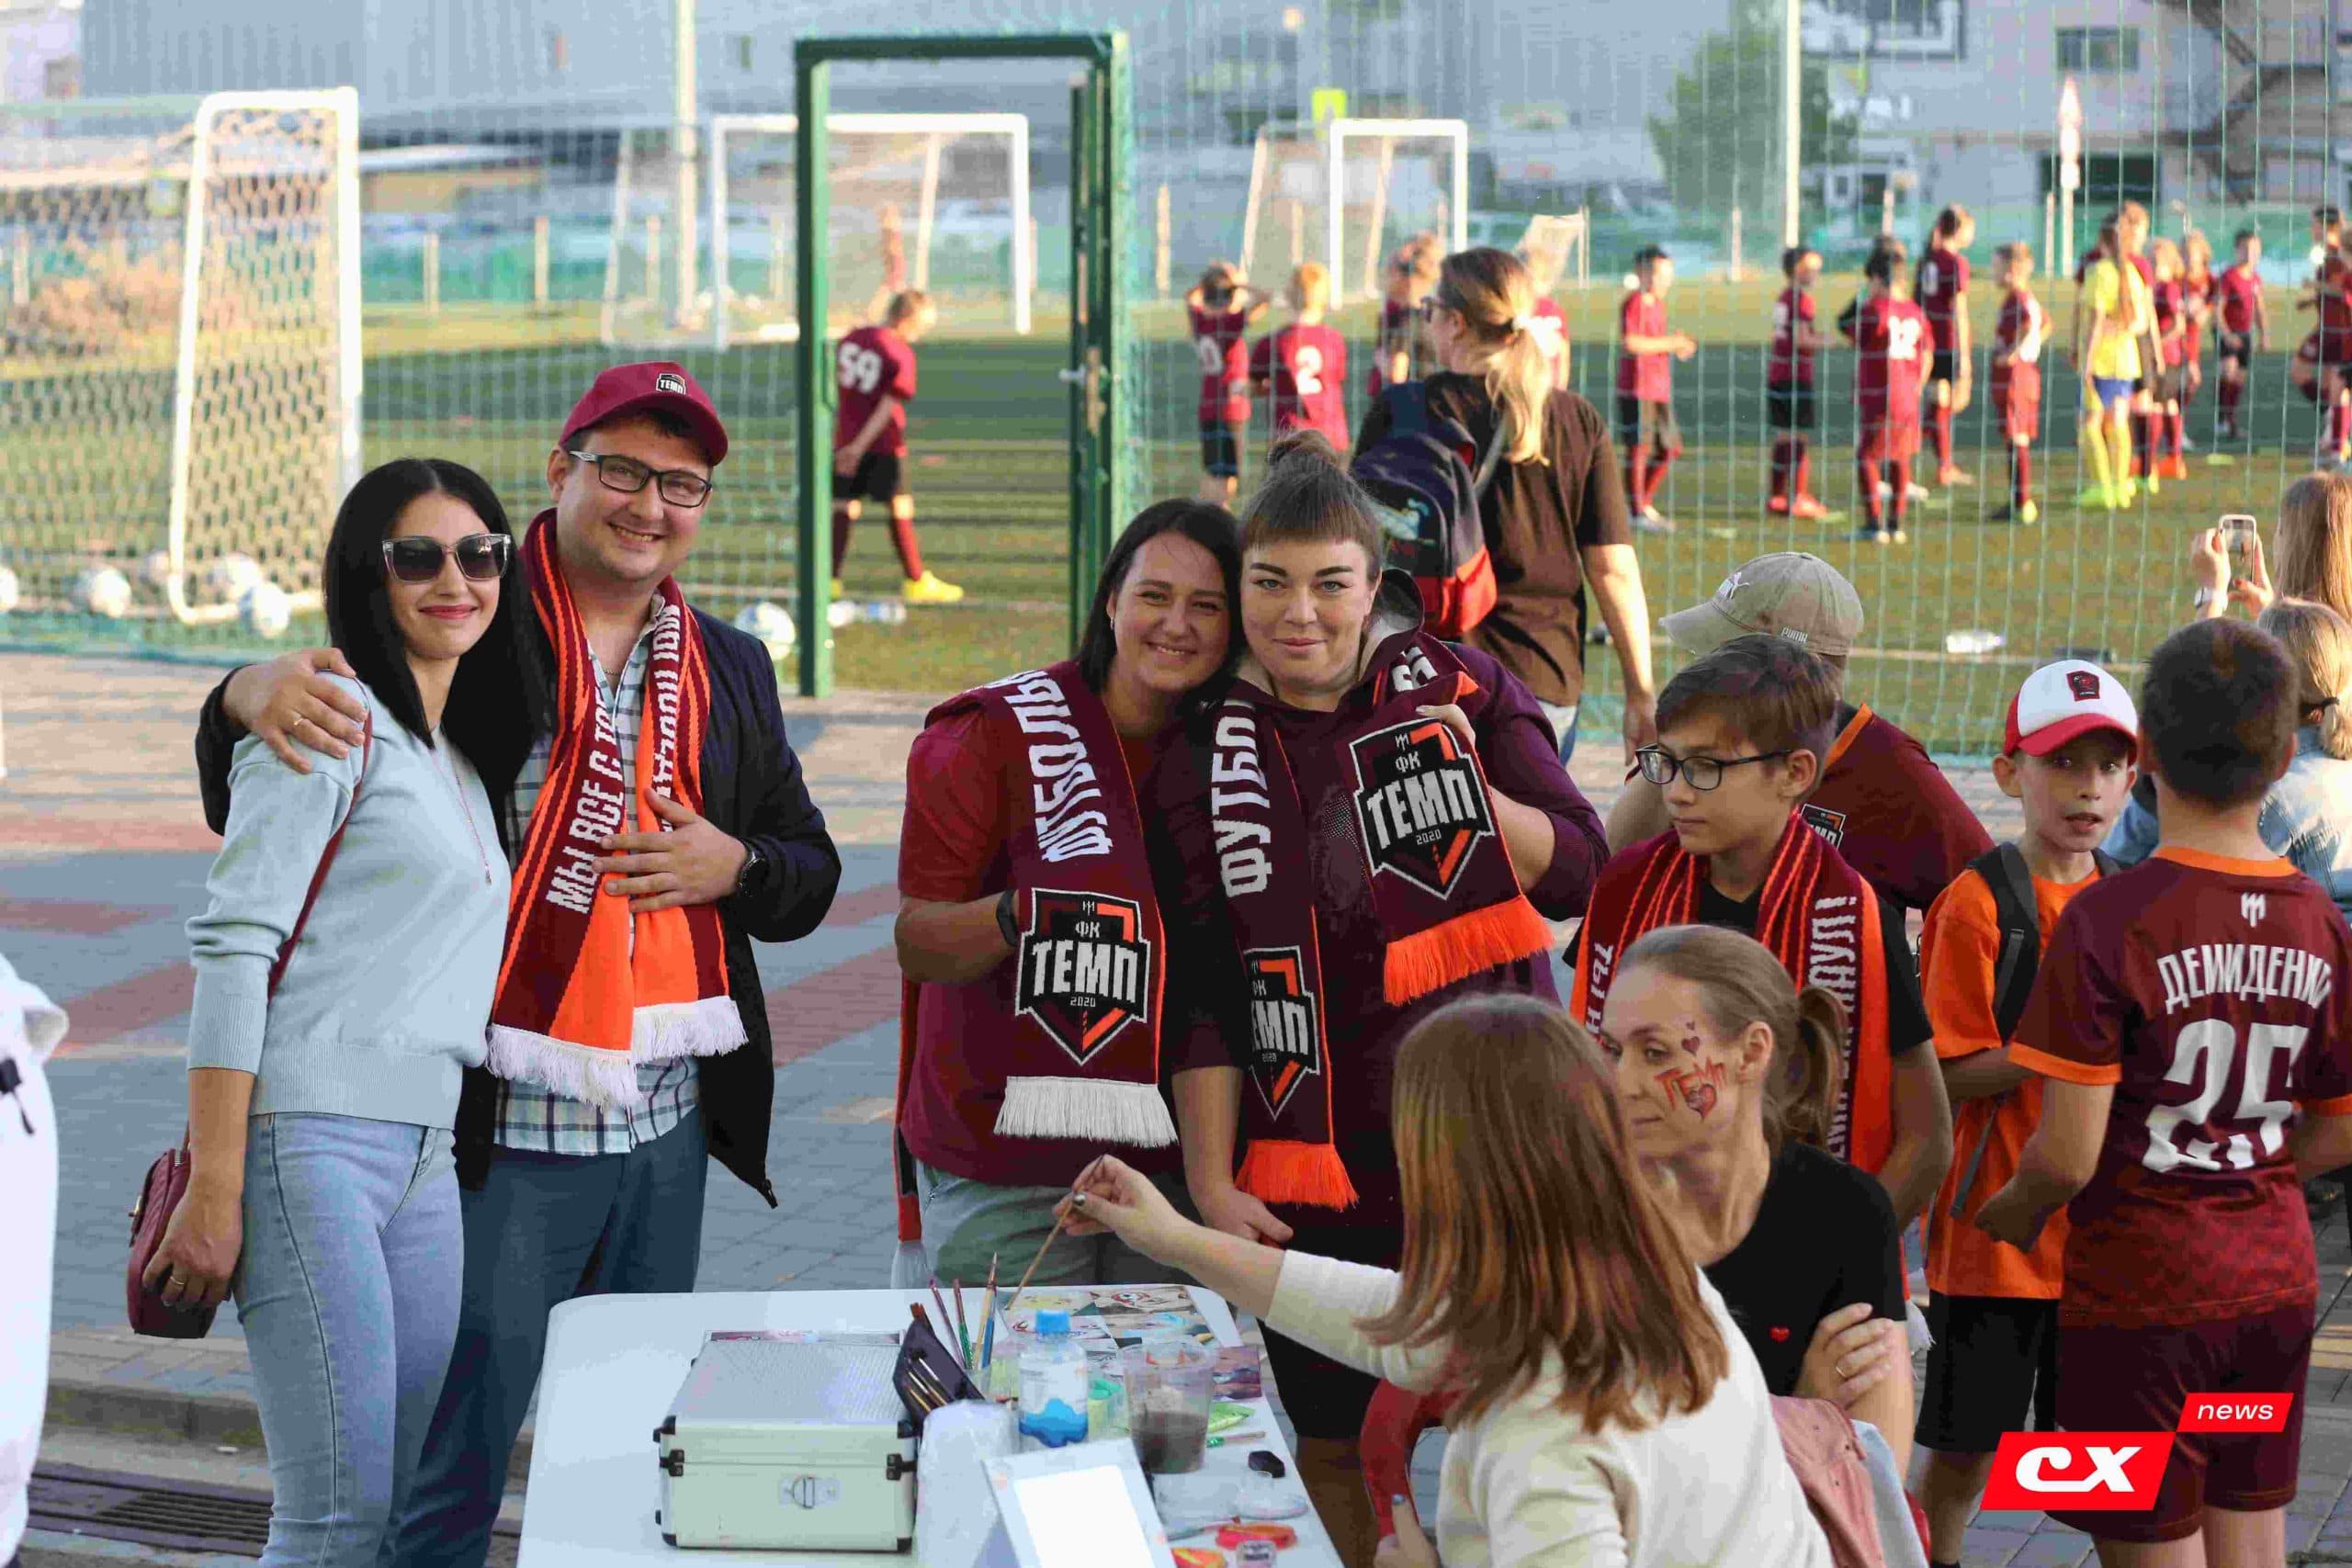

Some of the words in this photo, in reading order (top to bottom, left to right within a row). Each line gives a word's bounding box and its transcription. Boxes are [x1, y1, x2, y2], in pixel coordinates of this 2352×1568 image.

[1295, 345, 1323, 395] 2
[1396, 750, 1421, 773] ФК
[569, 779, 625, 844] ВСЕ
[1211, 699, 1273, 897] ФУТБО
[1367, 768, 1477, 851] ТЕМП
[1416, 829, 1442, 845] 2020
[546, 846, 599, 915] МЫ
[1075, 920, 1101, 939] ФК
[1032, 939, 1138, 1004] ТЕМП
[1069, 997, 1096, 1008] 2020
[2143, 1018, 2310, 1173] 25
